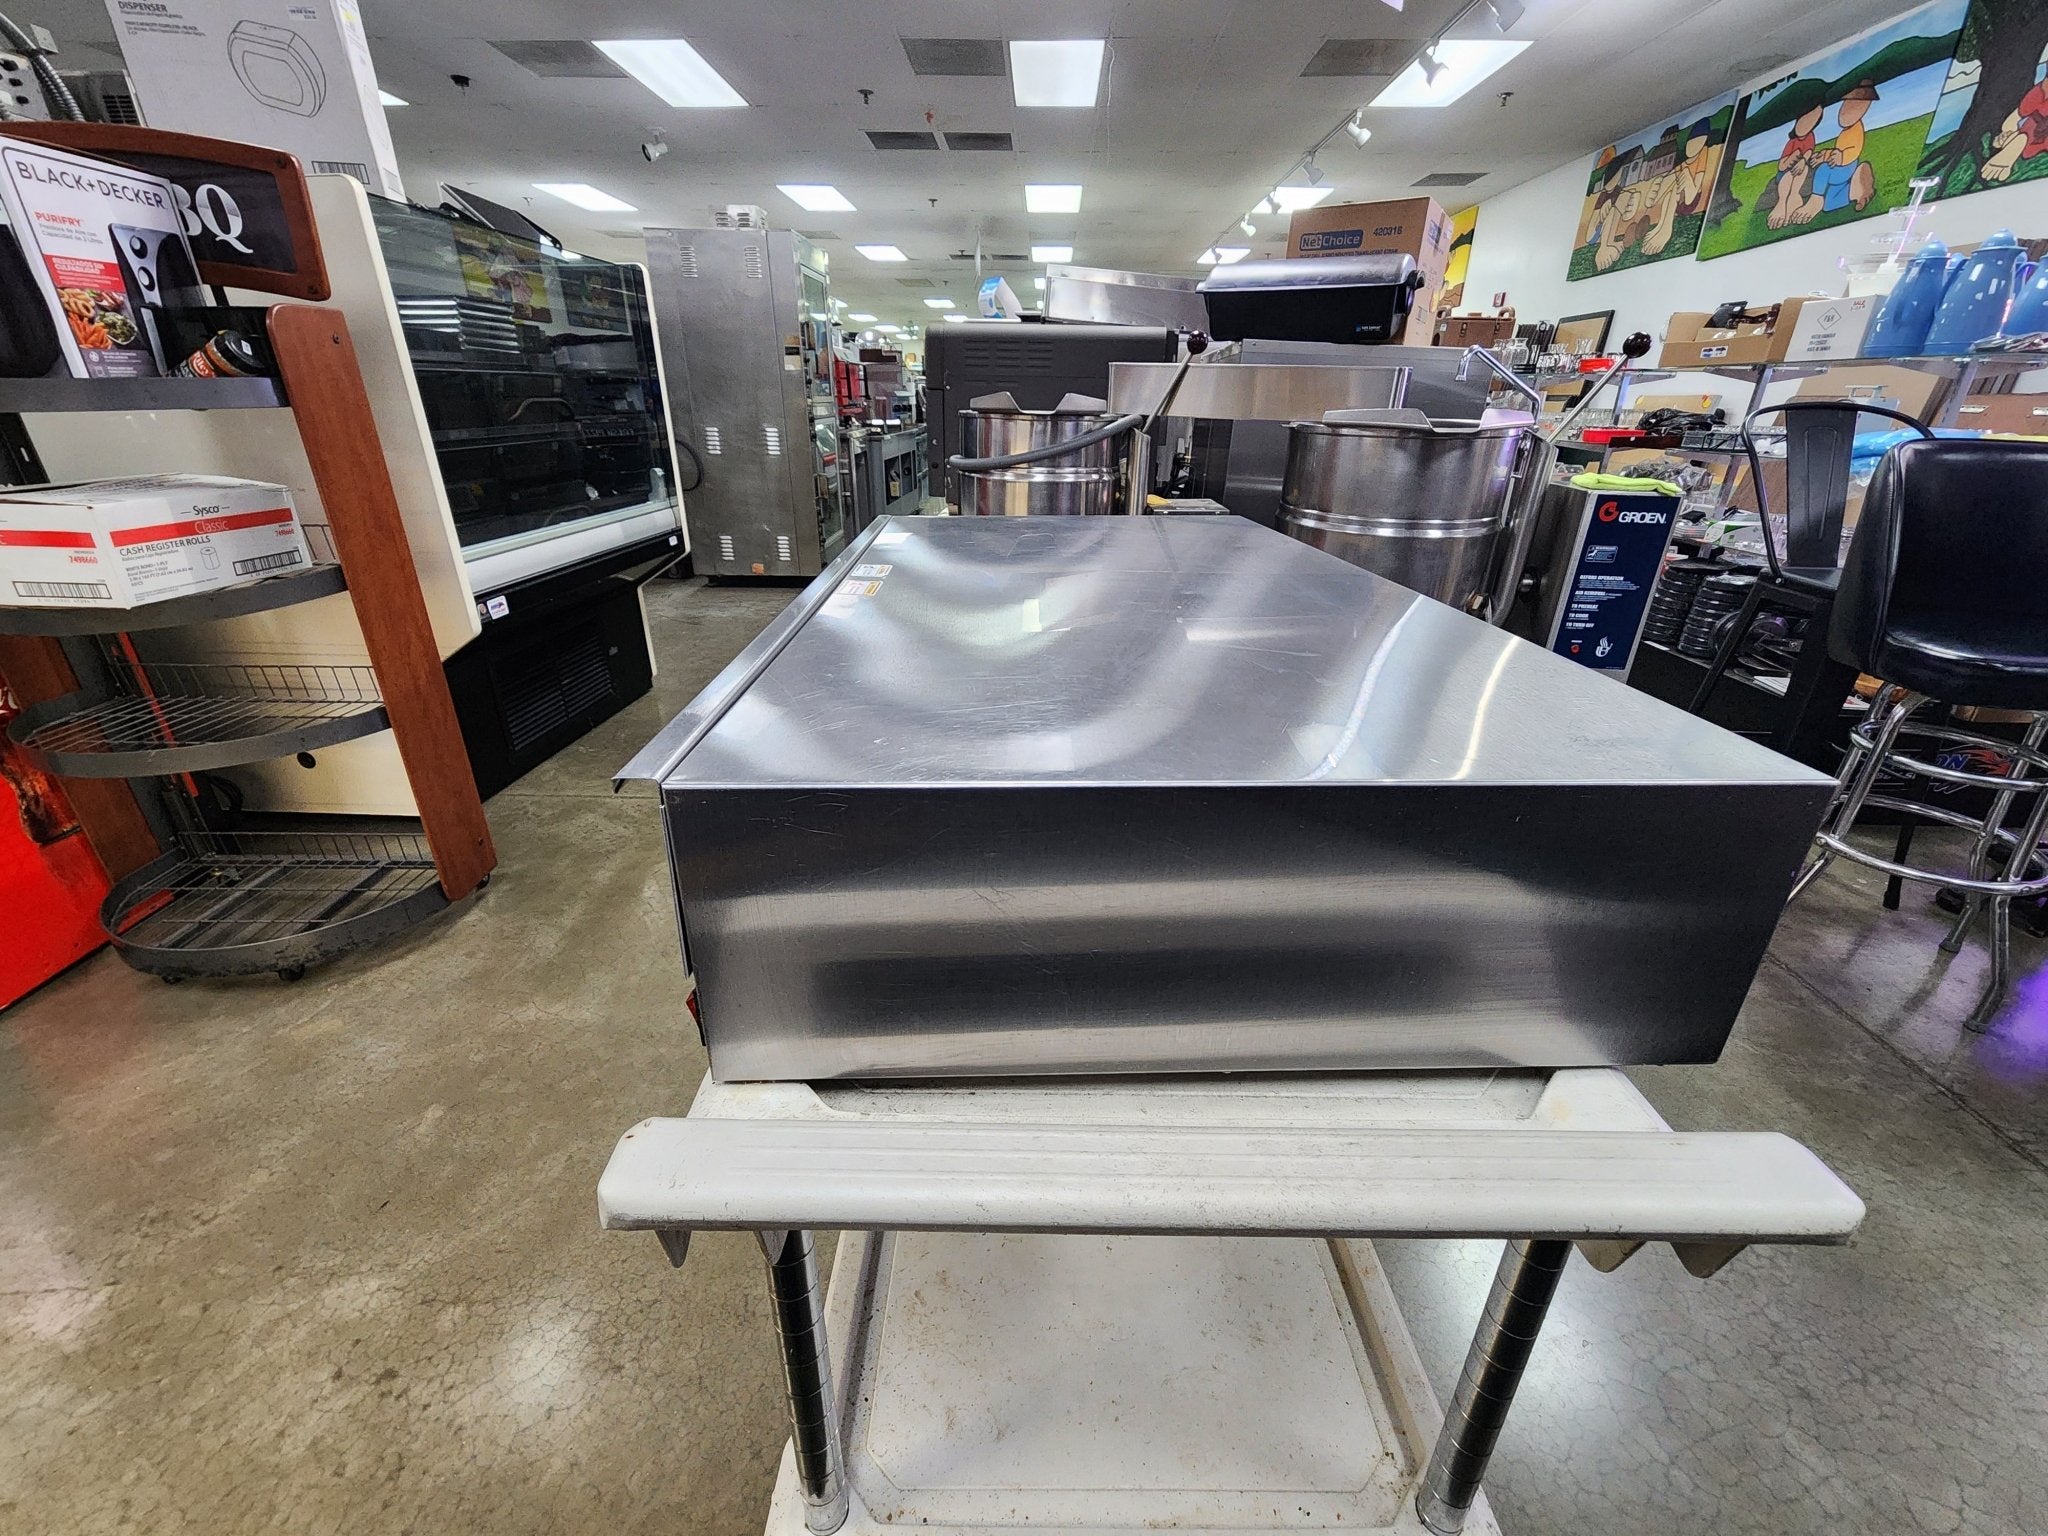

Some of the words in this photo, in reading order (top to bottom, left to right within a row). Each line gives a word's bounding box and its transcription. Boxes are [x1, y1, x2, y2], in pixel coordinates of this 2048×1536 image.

[118, 1, 168, 13] DISPENSER
[15, 160, 168, 210] BLACK+DECKER
[34, 211, 81, 227] PURIFRY
[193, 505, 220, 517] Sysco
[1618, 511, 1667, 524] GROEN
[194, 520, 229, 534] Classic
[120, 546, 145, 557] CASH
[146, 539, 186, 553] REGISTER
[186, 535, 211, 546] ROLLS
